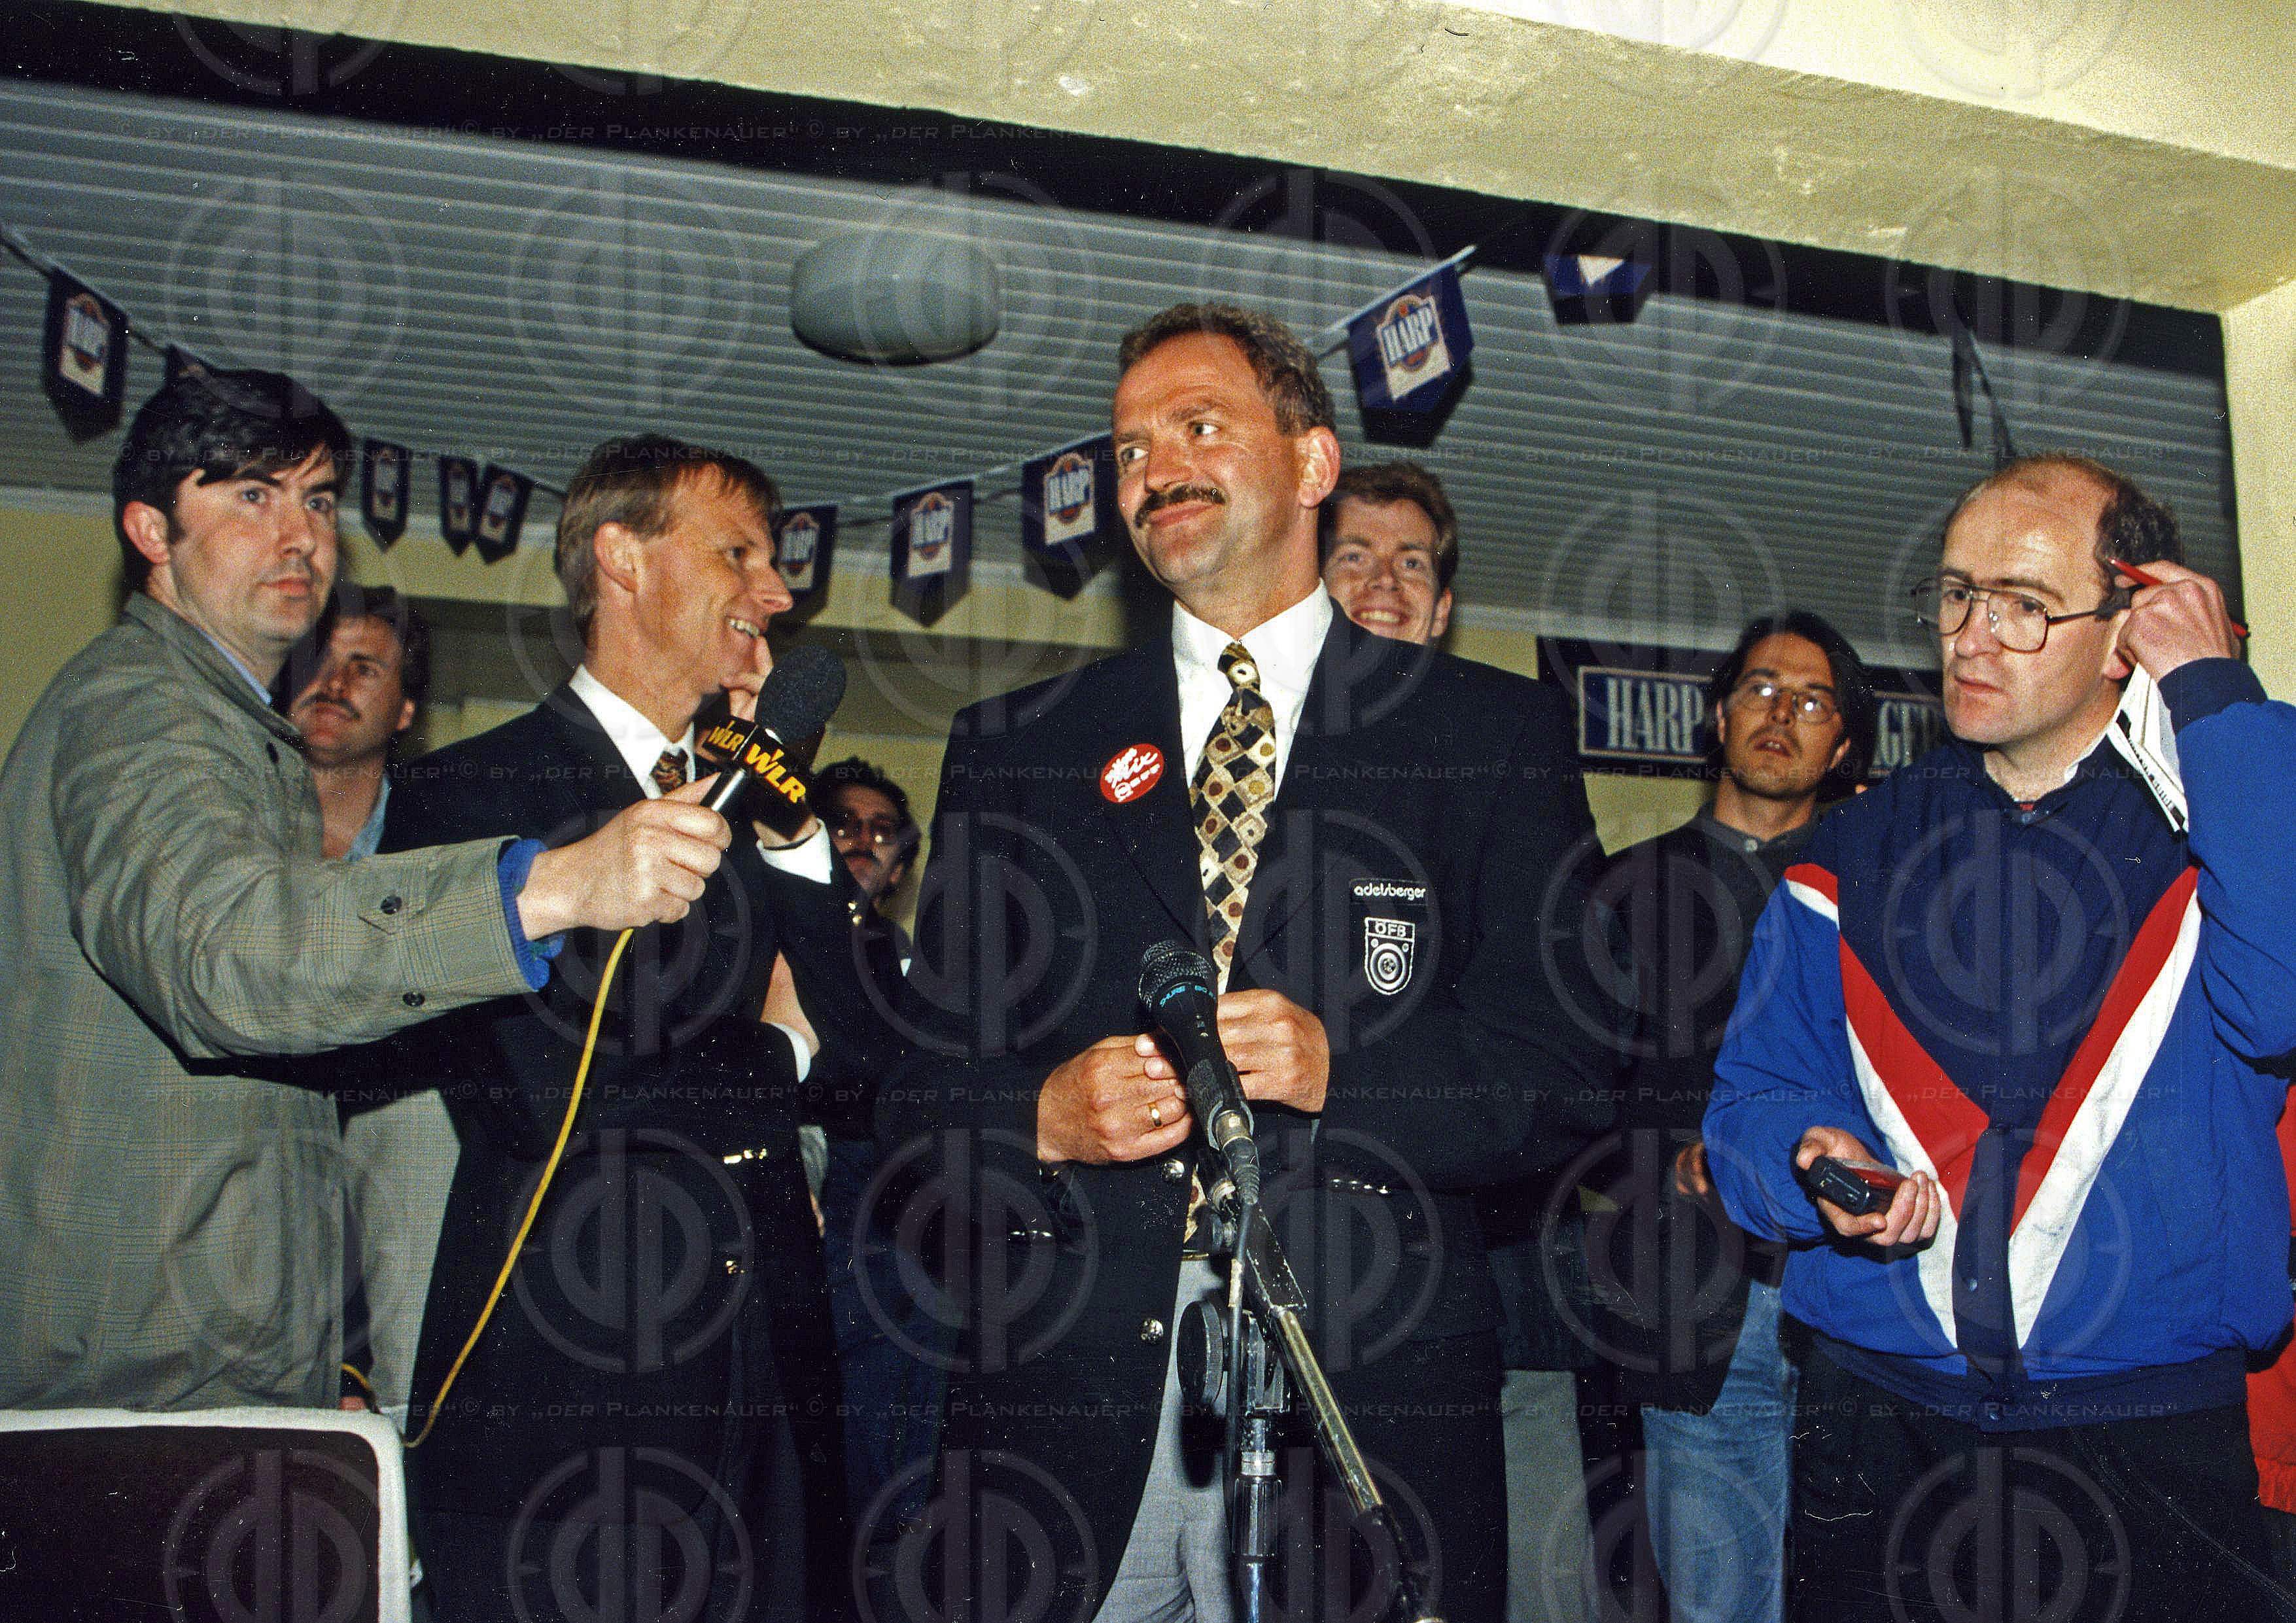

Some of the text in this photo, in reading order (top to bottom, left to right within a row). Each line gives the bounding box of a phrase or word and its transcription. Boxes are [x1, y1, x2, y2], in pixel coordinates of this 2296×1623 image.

[708, 720, 745, 752] WLR
[1606, 676, 1705, 753] HARP
[745, 743, 806, 803] WLR
[1353, 882, 1427, 901] adelsberger
